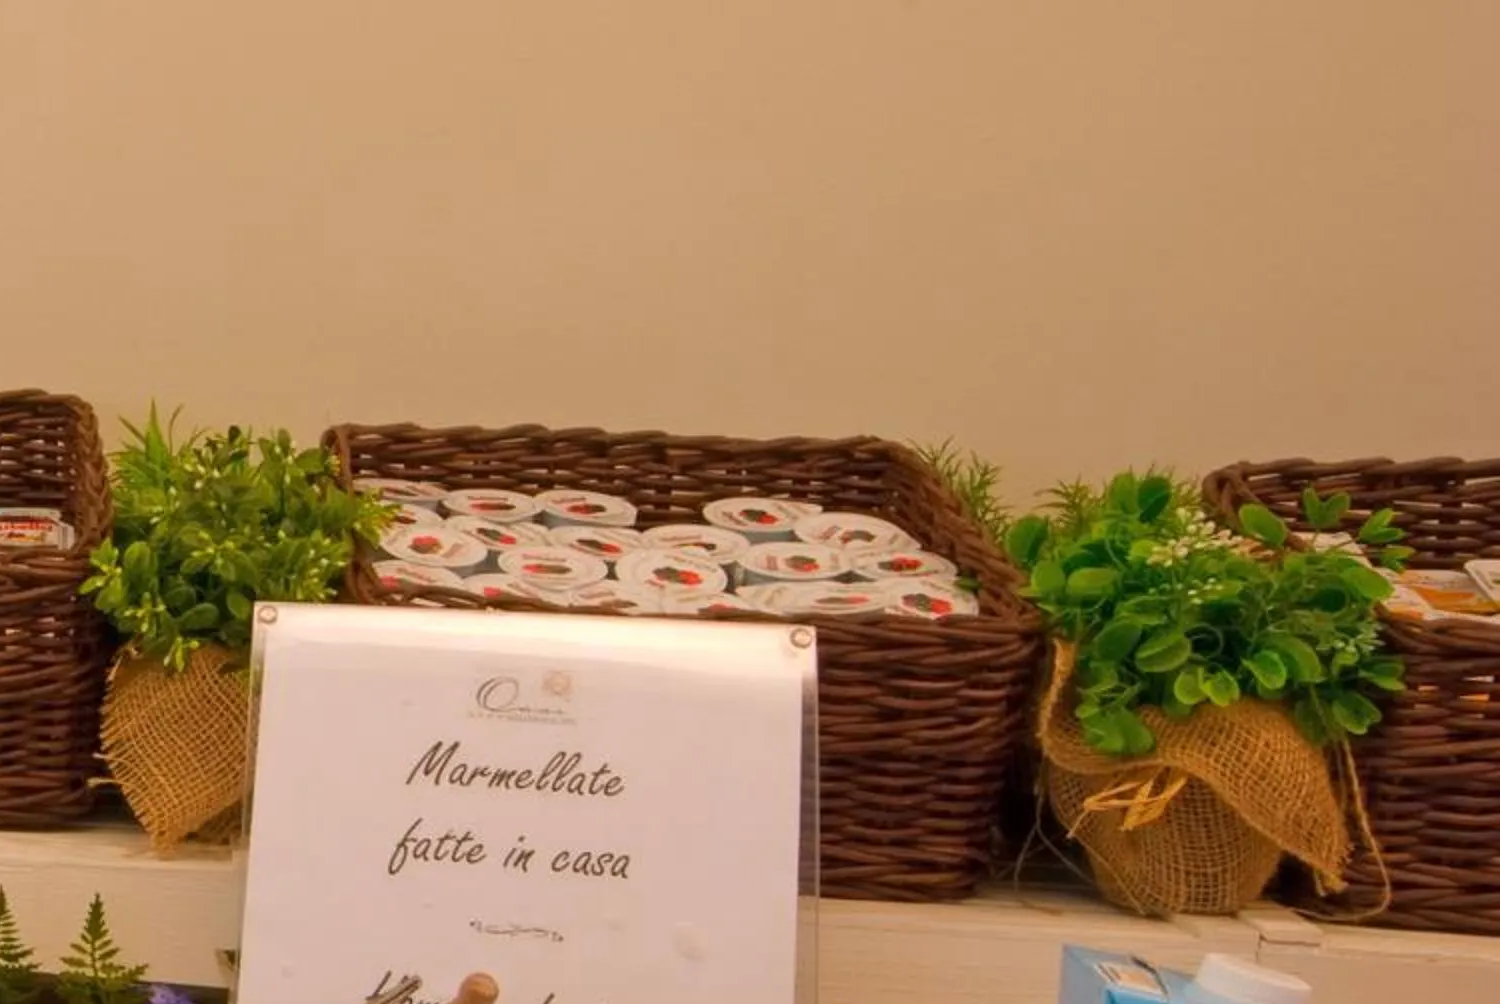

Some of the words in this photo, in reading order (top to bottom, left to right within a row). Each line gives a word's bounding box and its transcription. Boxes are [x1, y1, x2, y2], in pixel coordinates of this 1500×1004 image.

[405, 740, 626, 798] Marmellate
[387, 817, 487, 875] fatte
[502, 835, 535, 873] in
[550, 849, 631, 879] casa
